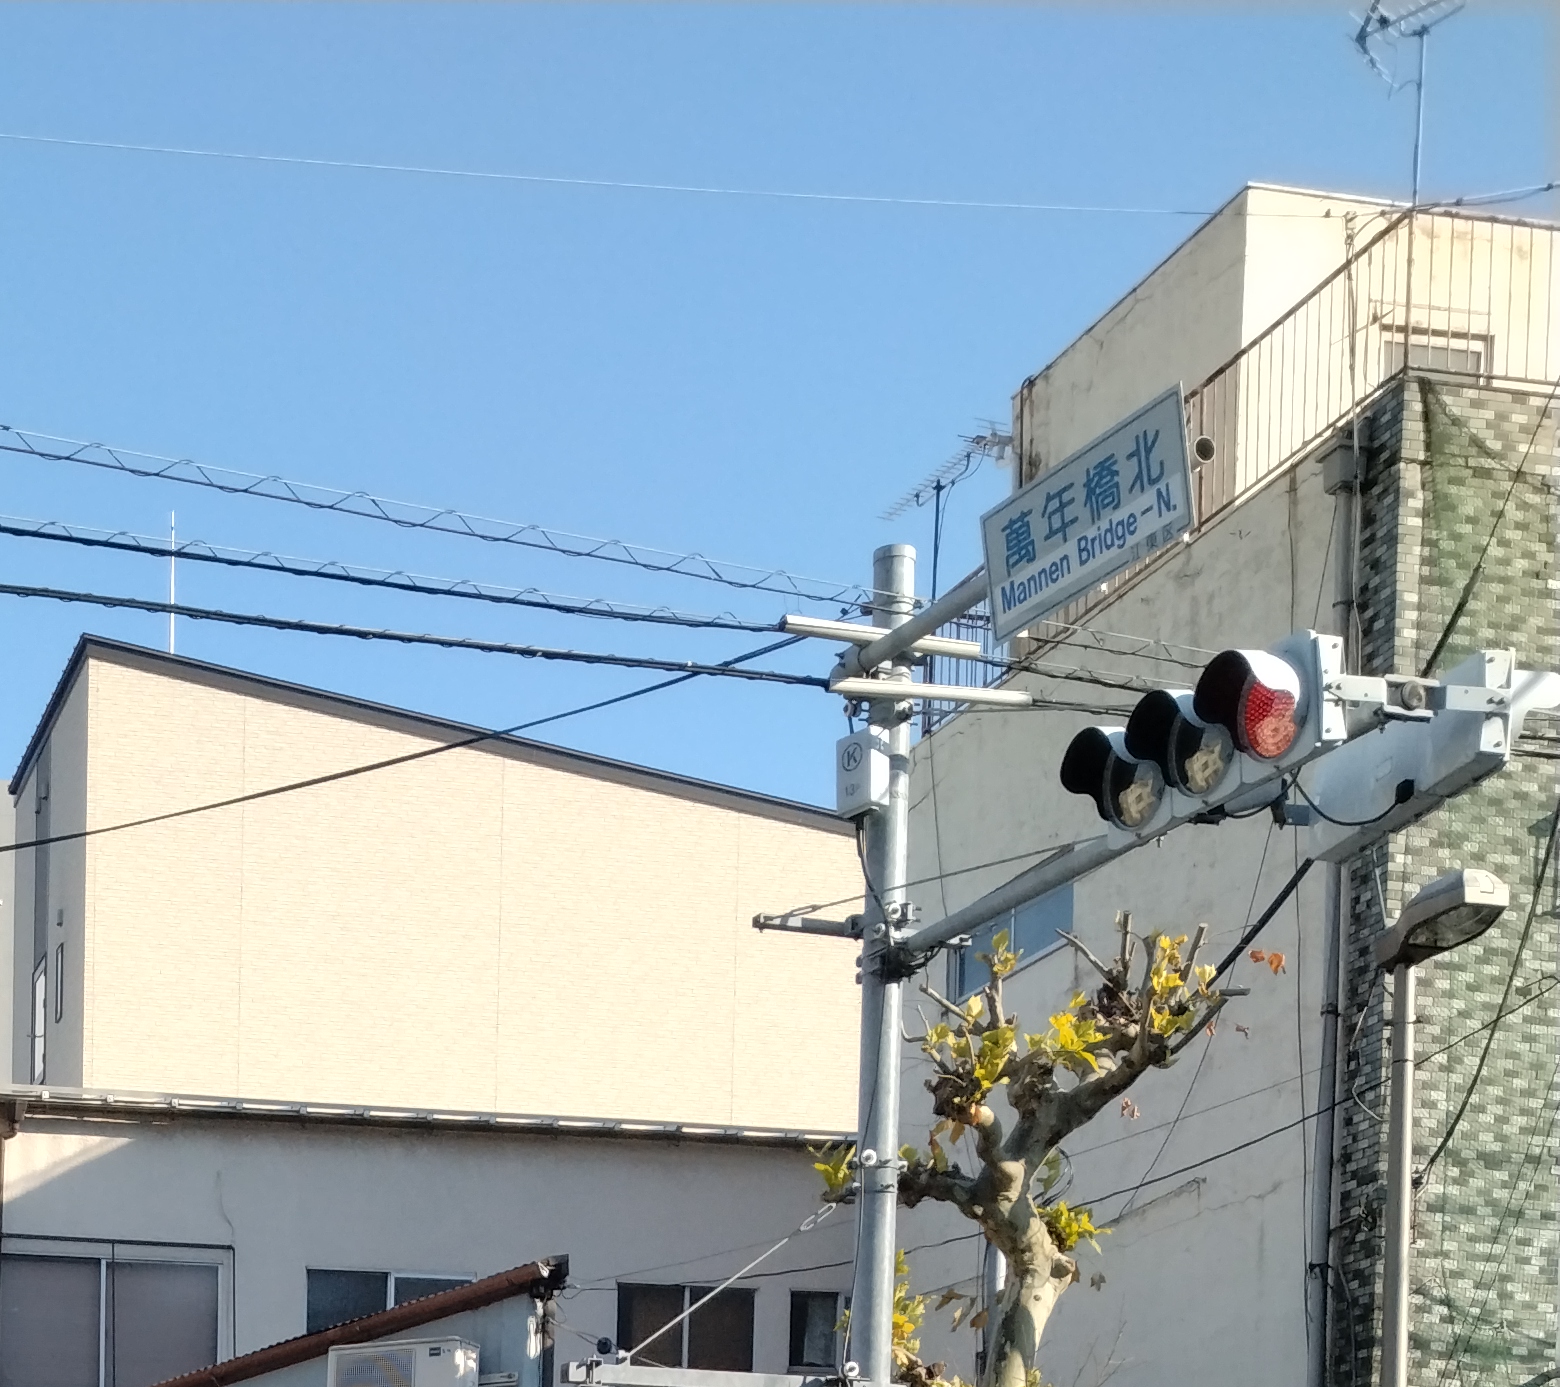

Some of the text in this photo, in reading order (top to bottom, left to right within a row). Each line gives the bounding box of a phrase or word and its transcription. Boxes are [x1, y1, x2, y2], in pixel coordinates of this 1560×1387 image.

[1001, 429, 1165, 576] 萬年橋北
[1000, 553, 1071, 614] Mannen
